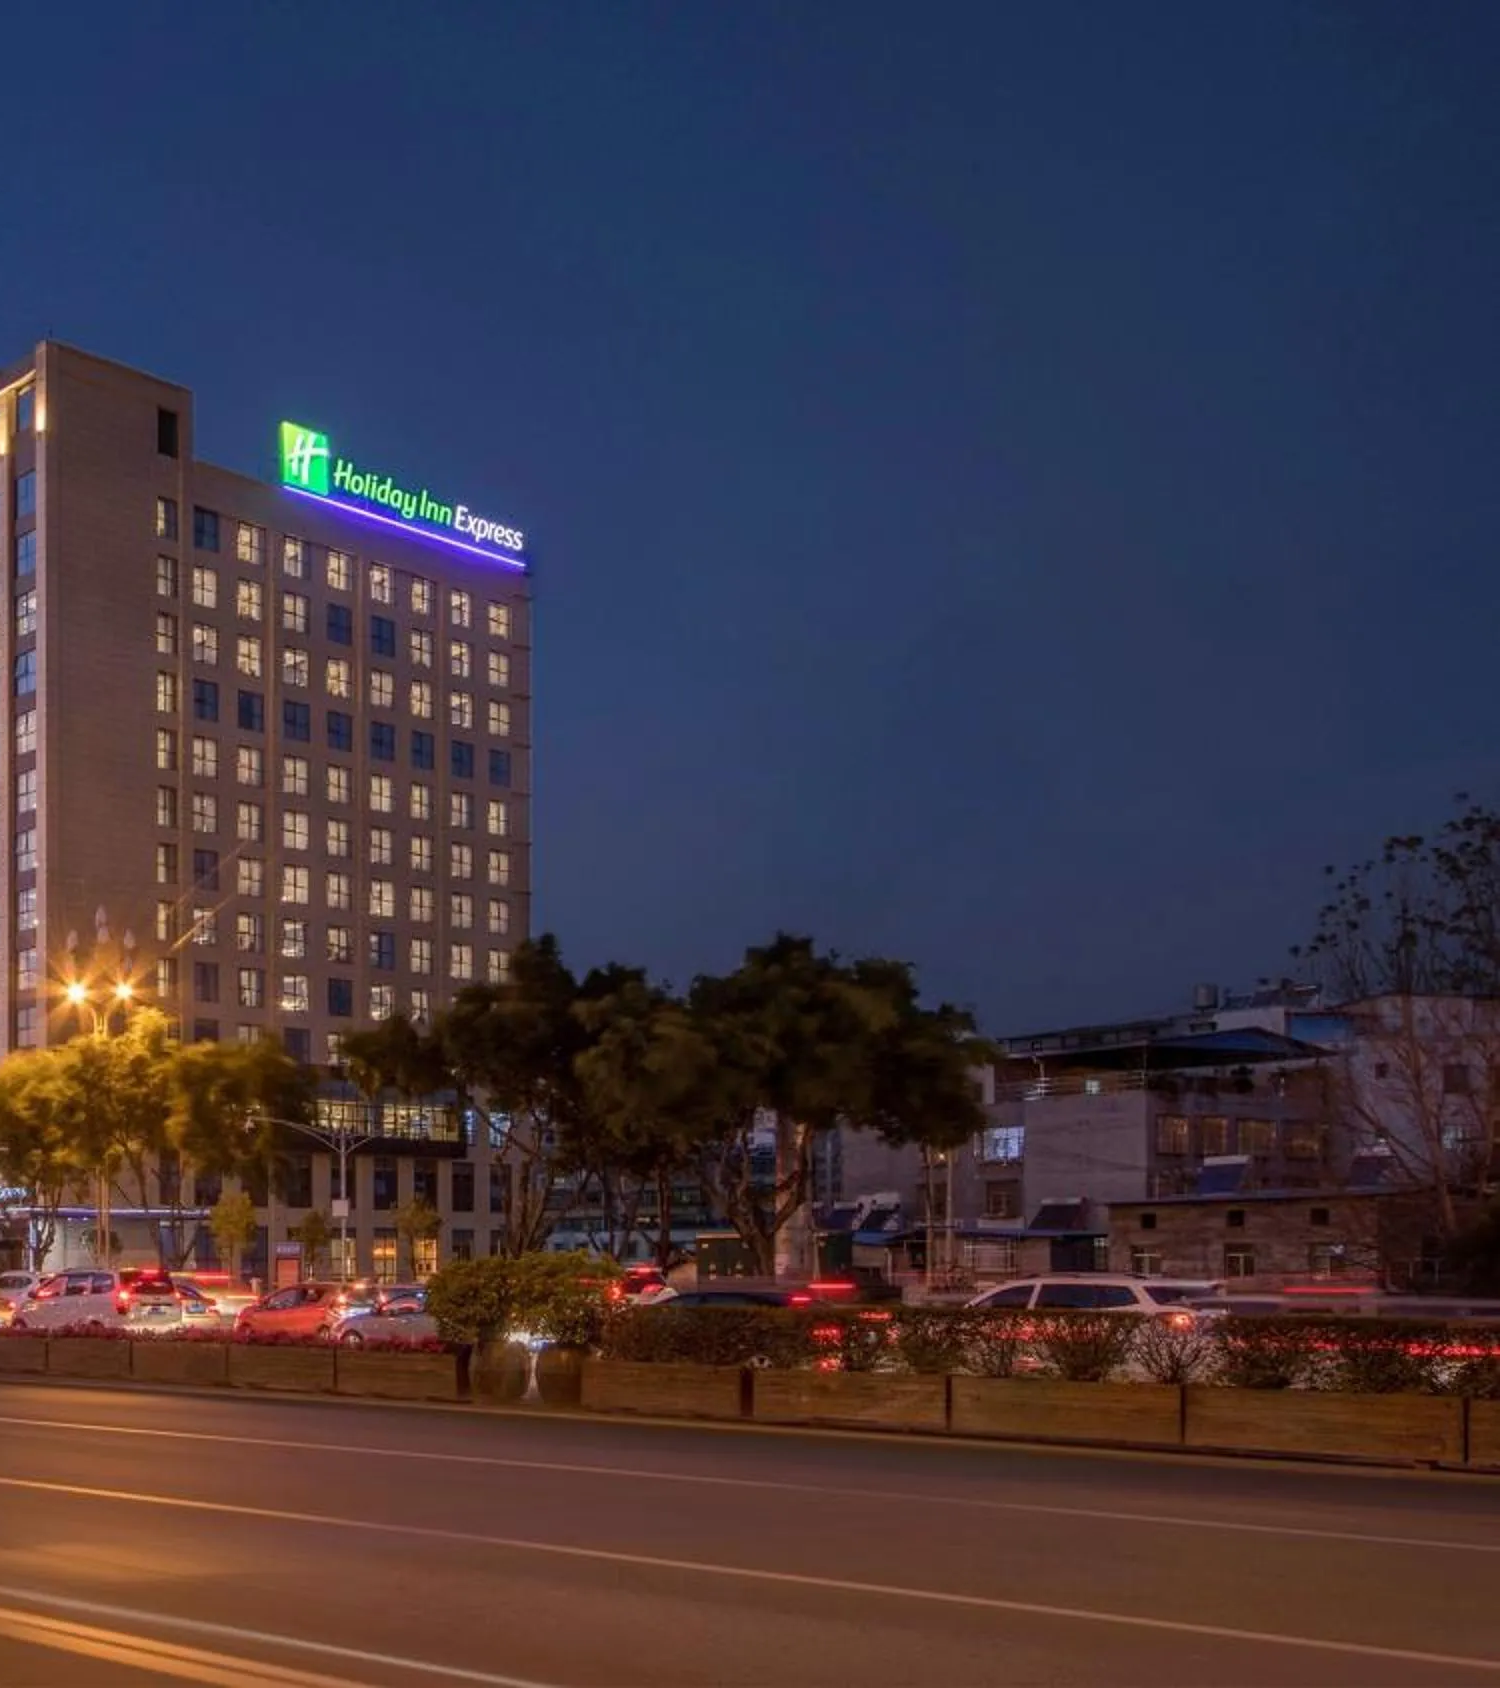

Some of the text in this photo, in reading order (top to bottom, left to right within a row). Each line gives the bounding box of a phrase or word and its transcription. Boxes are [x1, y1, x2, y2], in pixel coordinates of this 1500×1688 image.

[334, 459, 524, 550] Holiday Inn Express
